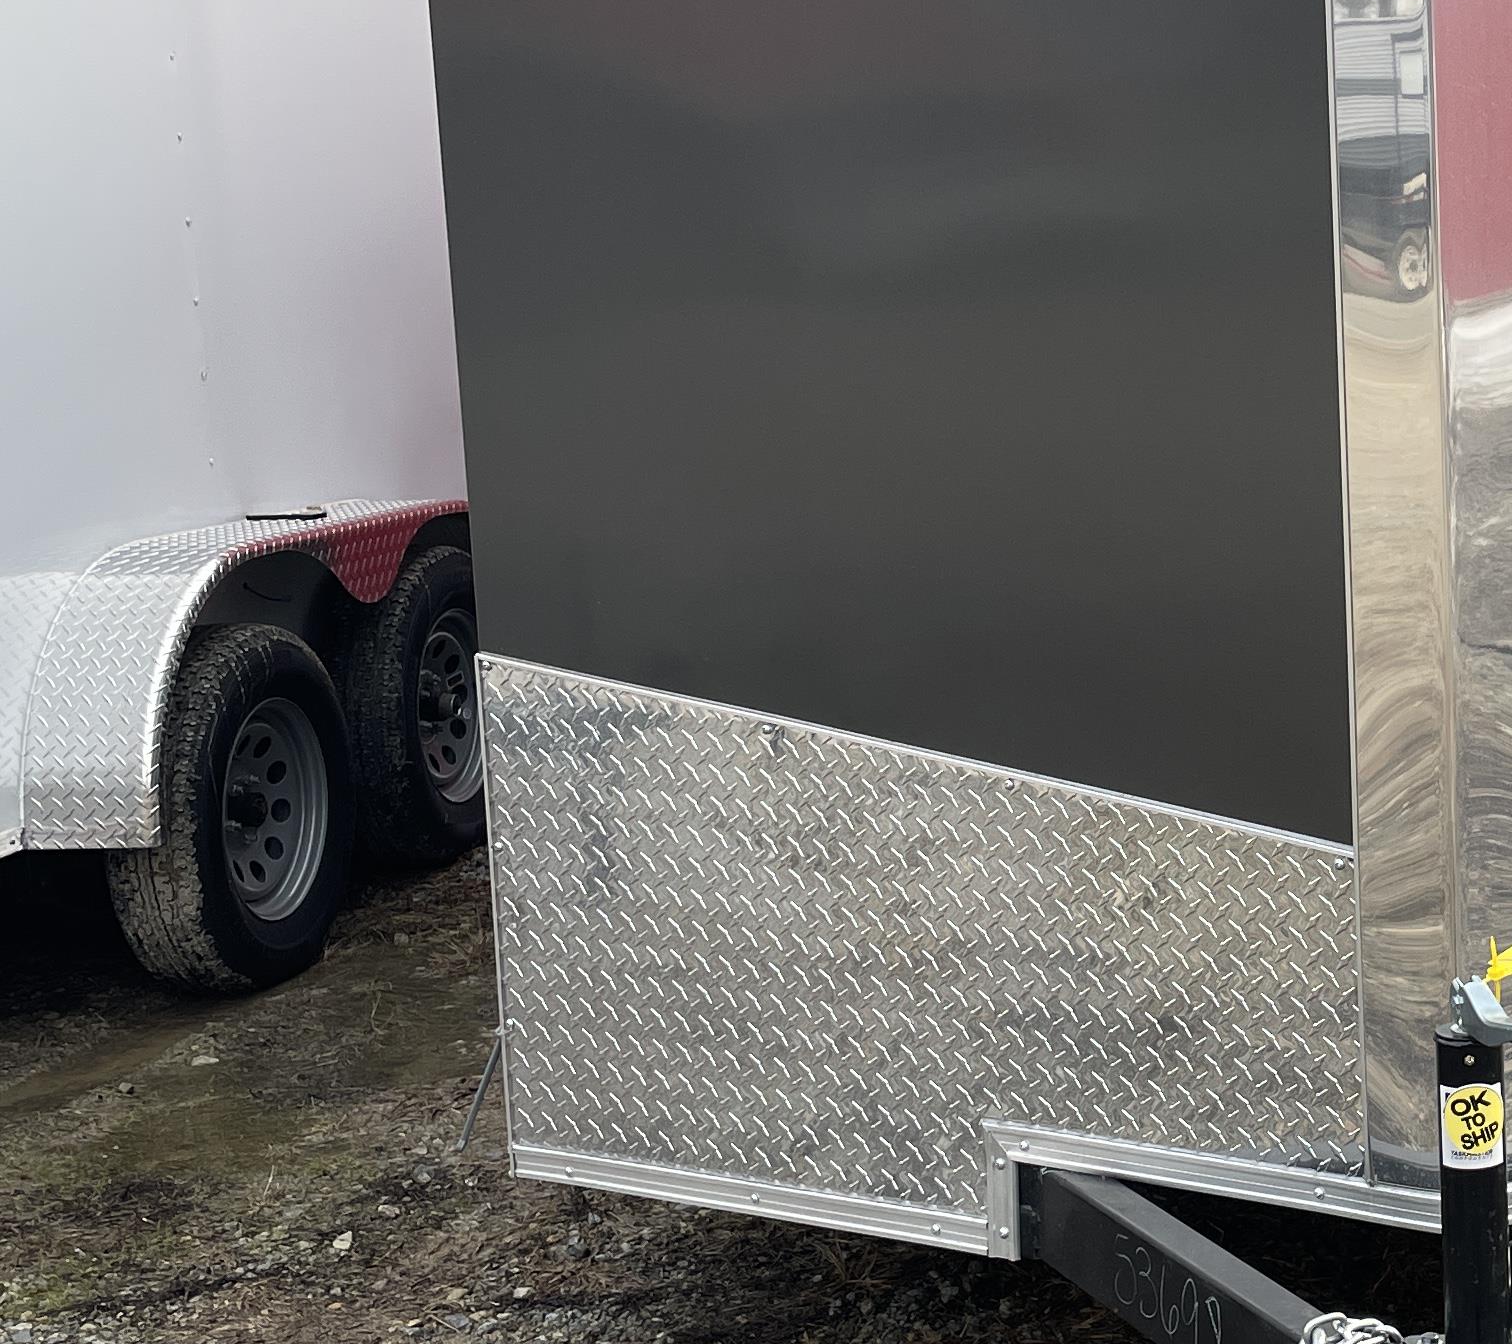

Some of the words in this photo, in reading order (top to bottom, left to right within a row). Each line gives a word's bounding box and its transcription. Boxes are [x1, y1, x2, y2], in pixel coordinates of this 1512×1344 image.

[1450, 1088, 1492, 1117] OK
[1460, 1112, 1486, 1131] TO
[1460, 1121, 1499, 1151] SHIP
